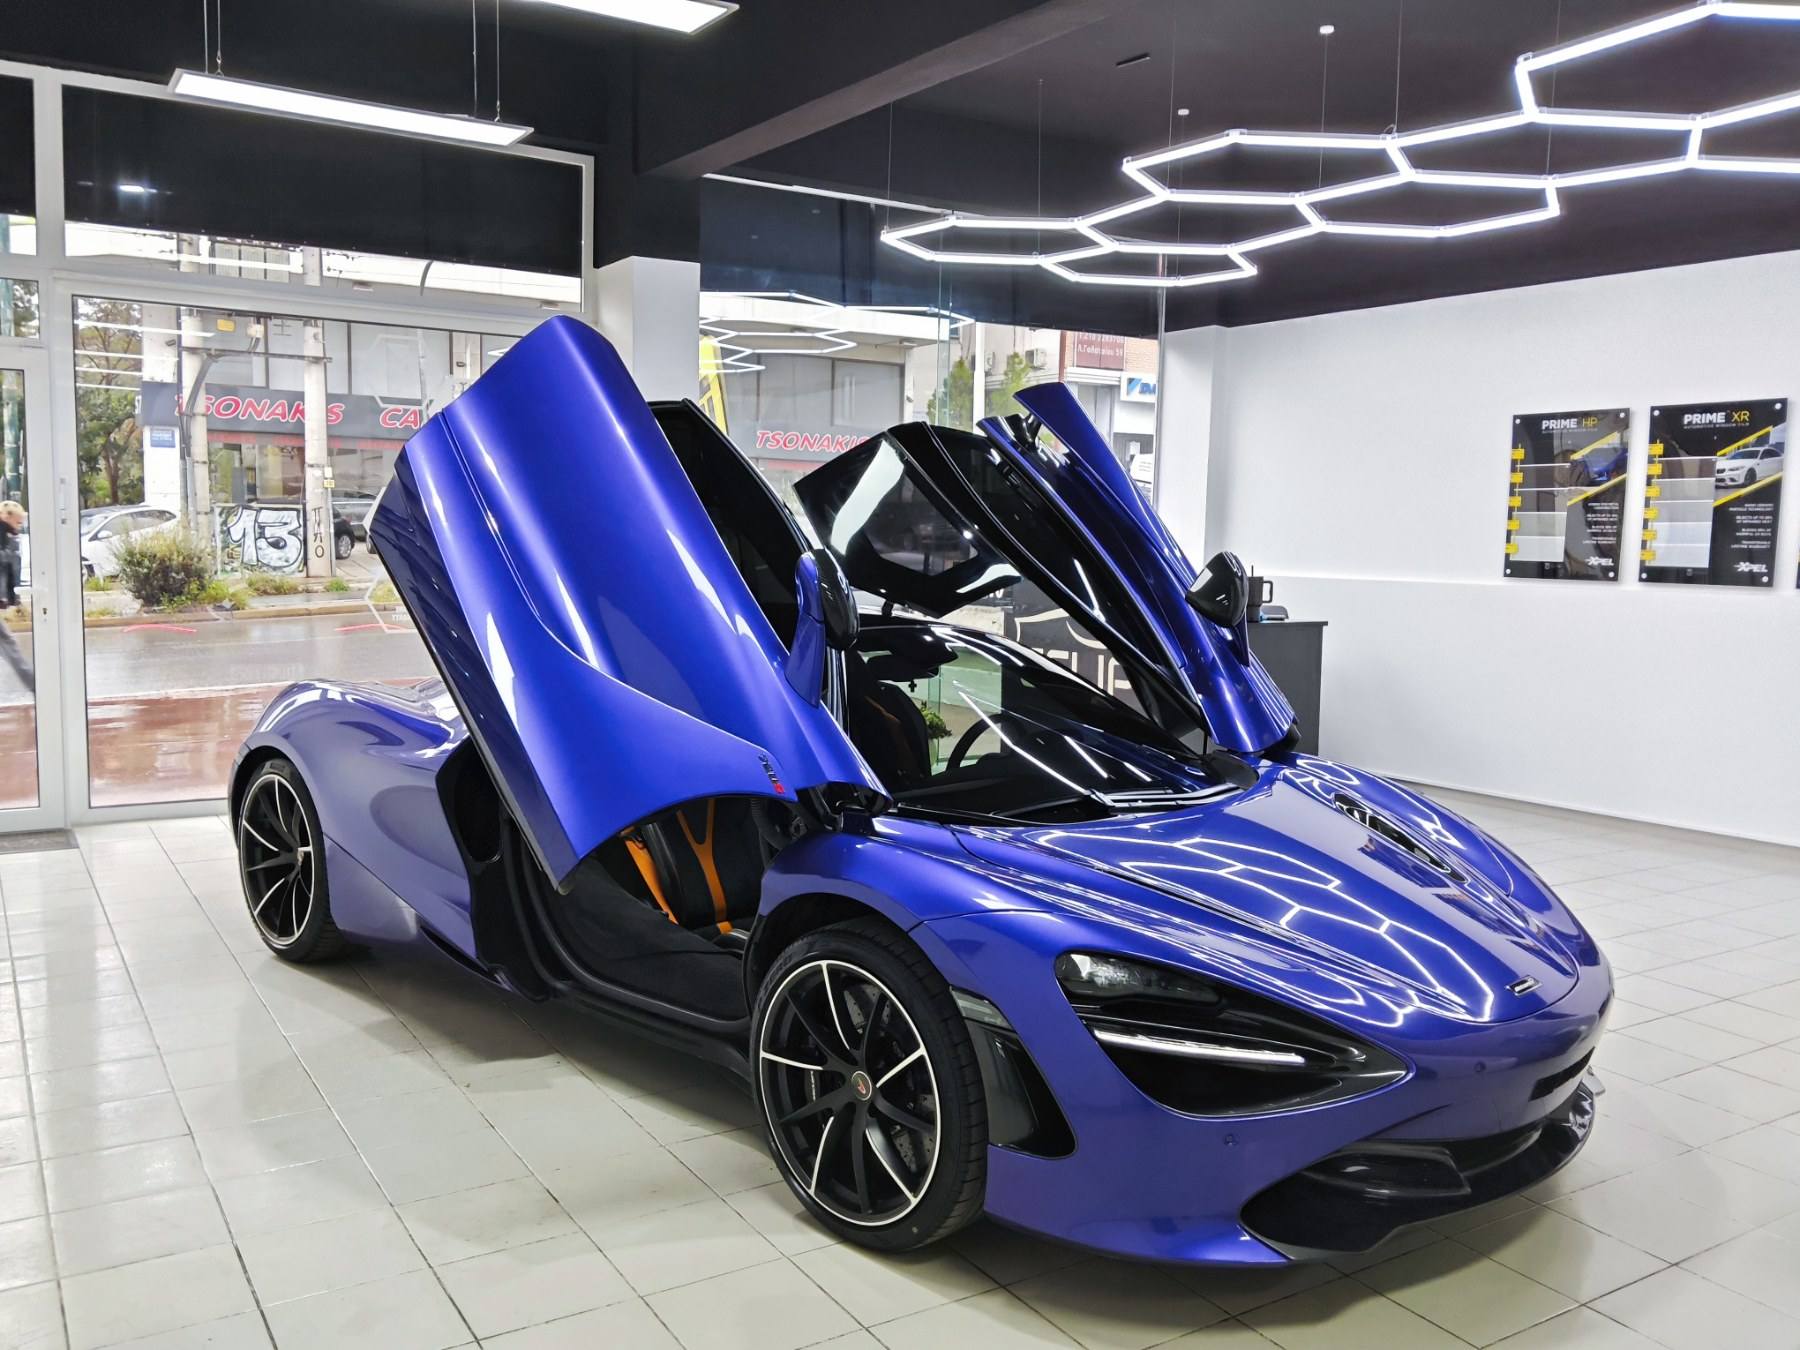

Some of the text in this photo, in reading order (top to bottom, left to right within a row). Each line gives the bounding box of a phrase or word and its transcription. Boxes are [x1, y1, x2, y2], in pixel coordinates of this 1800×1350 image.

[174, 393, 345, 425] SONAKS
[1541, 416, 1599, 430] PRIME HP
[1683, 410, 1750, 425] PRIME XR
[1733, 561, 1769, 573] XPEL
